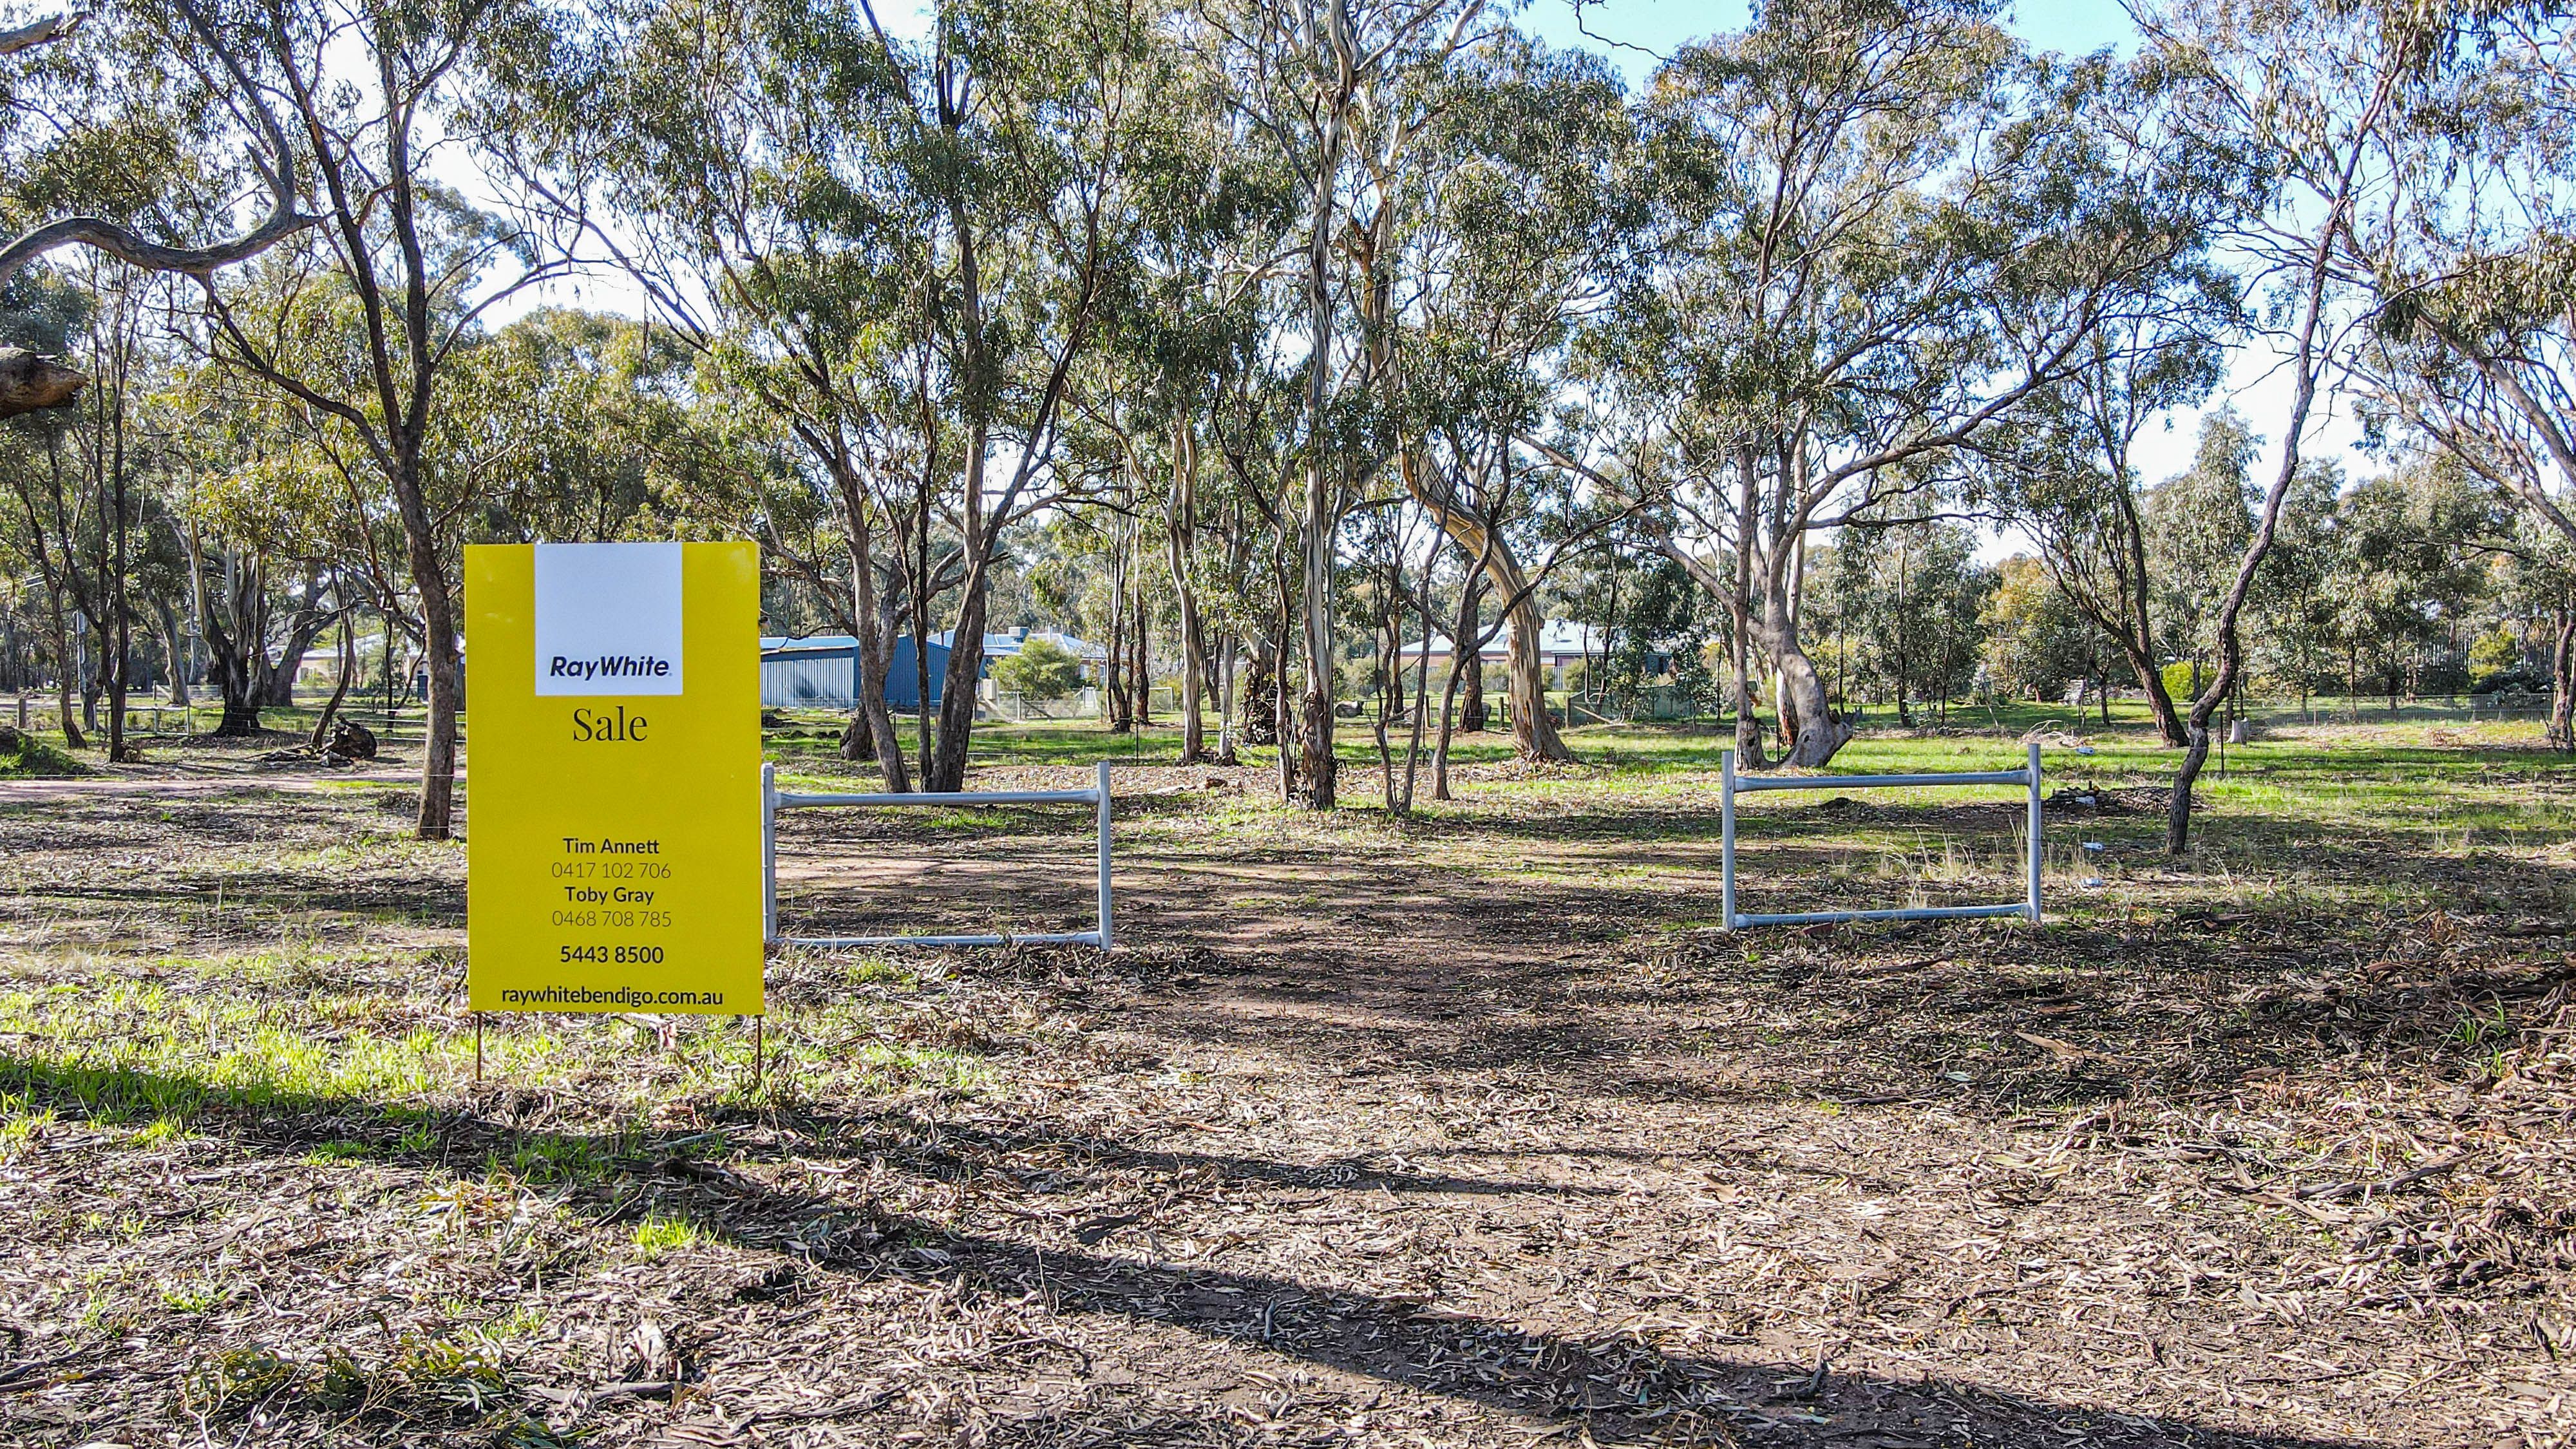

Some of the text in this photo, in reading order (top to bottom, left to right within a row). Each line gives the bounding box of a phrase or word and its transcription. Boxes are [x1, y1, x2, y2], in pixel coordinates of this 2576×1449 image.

[574, 706, 648, 741] Sale
[563, 838, 659, 854] Tim Annett
[552, 862, 671, 878] 0417 102 706
[564, 887, 654, 905] Toby Gray
[553, 911, 671, 927] 0468 708 785
[560, 945, 664, 964] 5443 8500
[502, 985, 723, 1008] raywhitebendigo.com.au
